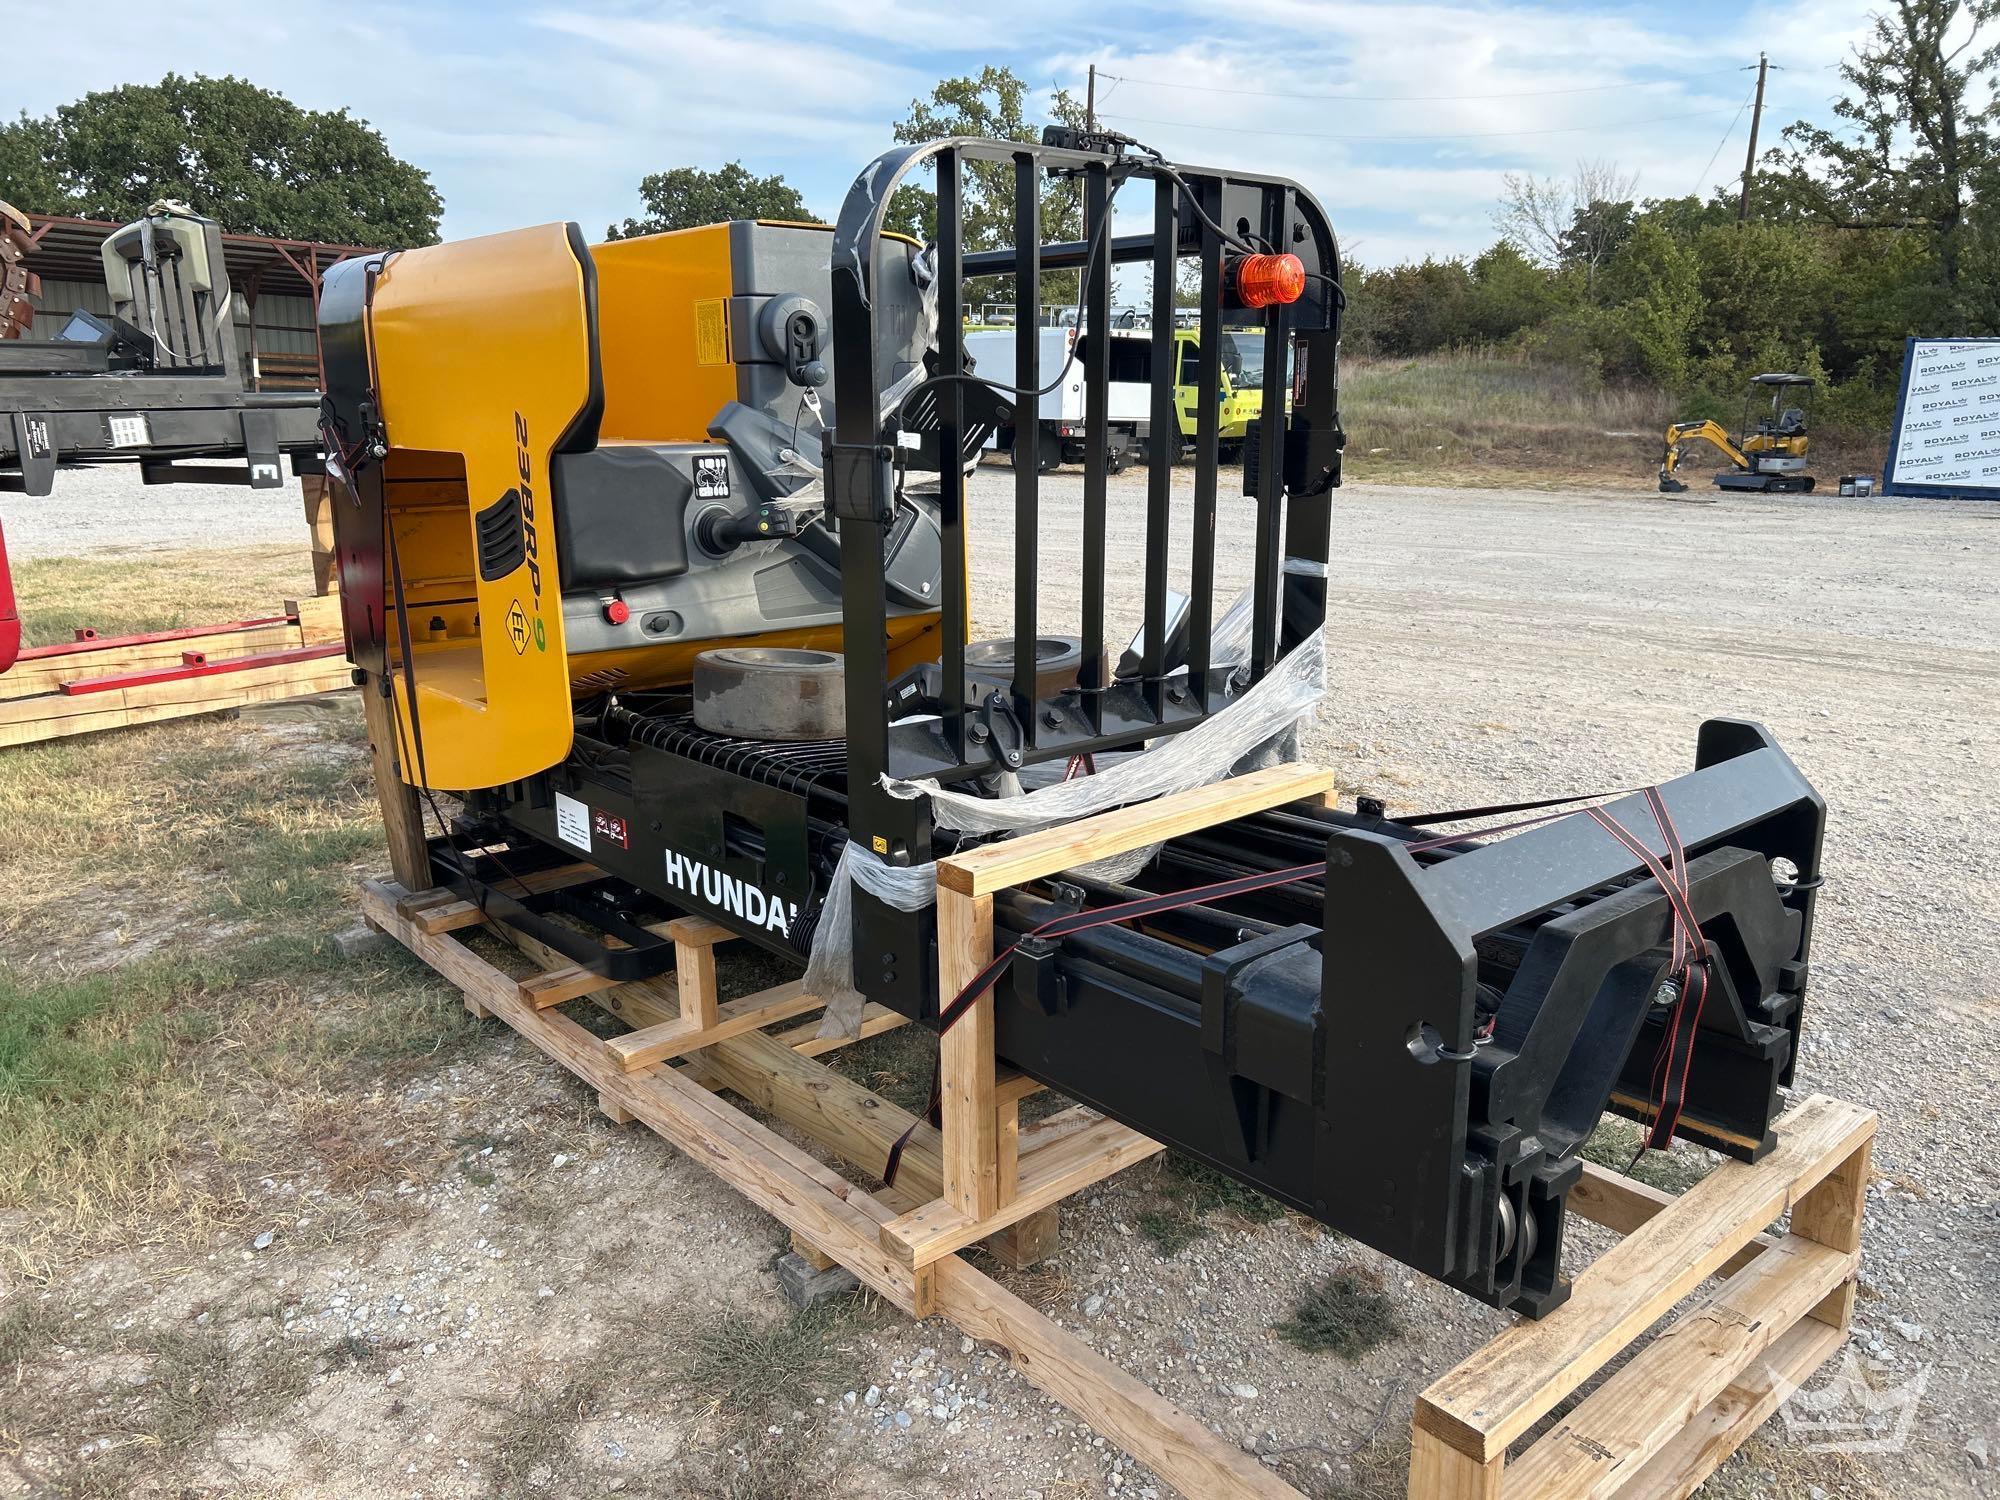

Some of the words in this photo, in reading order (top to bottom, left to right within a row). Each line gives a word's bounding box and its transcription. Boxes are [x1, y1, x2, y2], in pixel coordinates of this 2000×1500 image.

[1921, 364, 1956, 373] ROYAL
[1952, 377, 1987, 387] ROYAL
[1923, 400, 1958, 409] ROYAL
[1953, 414, 1989, 422] ROYAL
[1905, 421, 1932, 429] OYAL
[1925, 436, 1959, 444] ROYAL
[1955, 450, 1991, 458] ROYAL
[1900, 457, 1934, 465] ROYAL
[1926, 472, 1960, 480] ROYAL
[514, 410, 545, 652] 23BRP-9
[512, 611, 524, 644] EE
